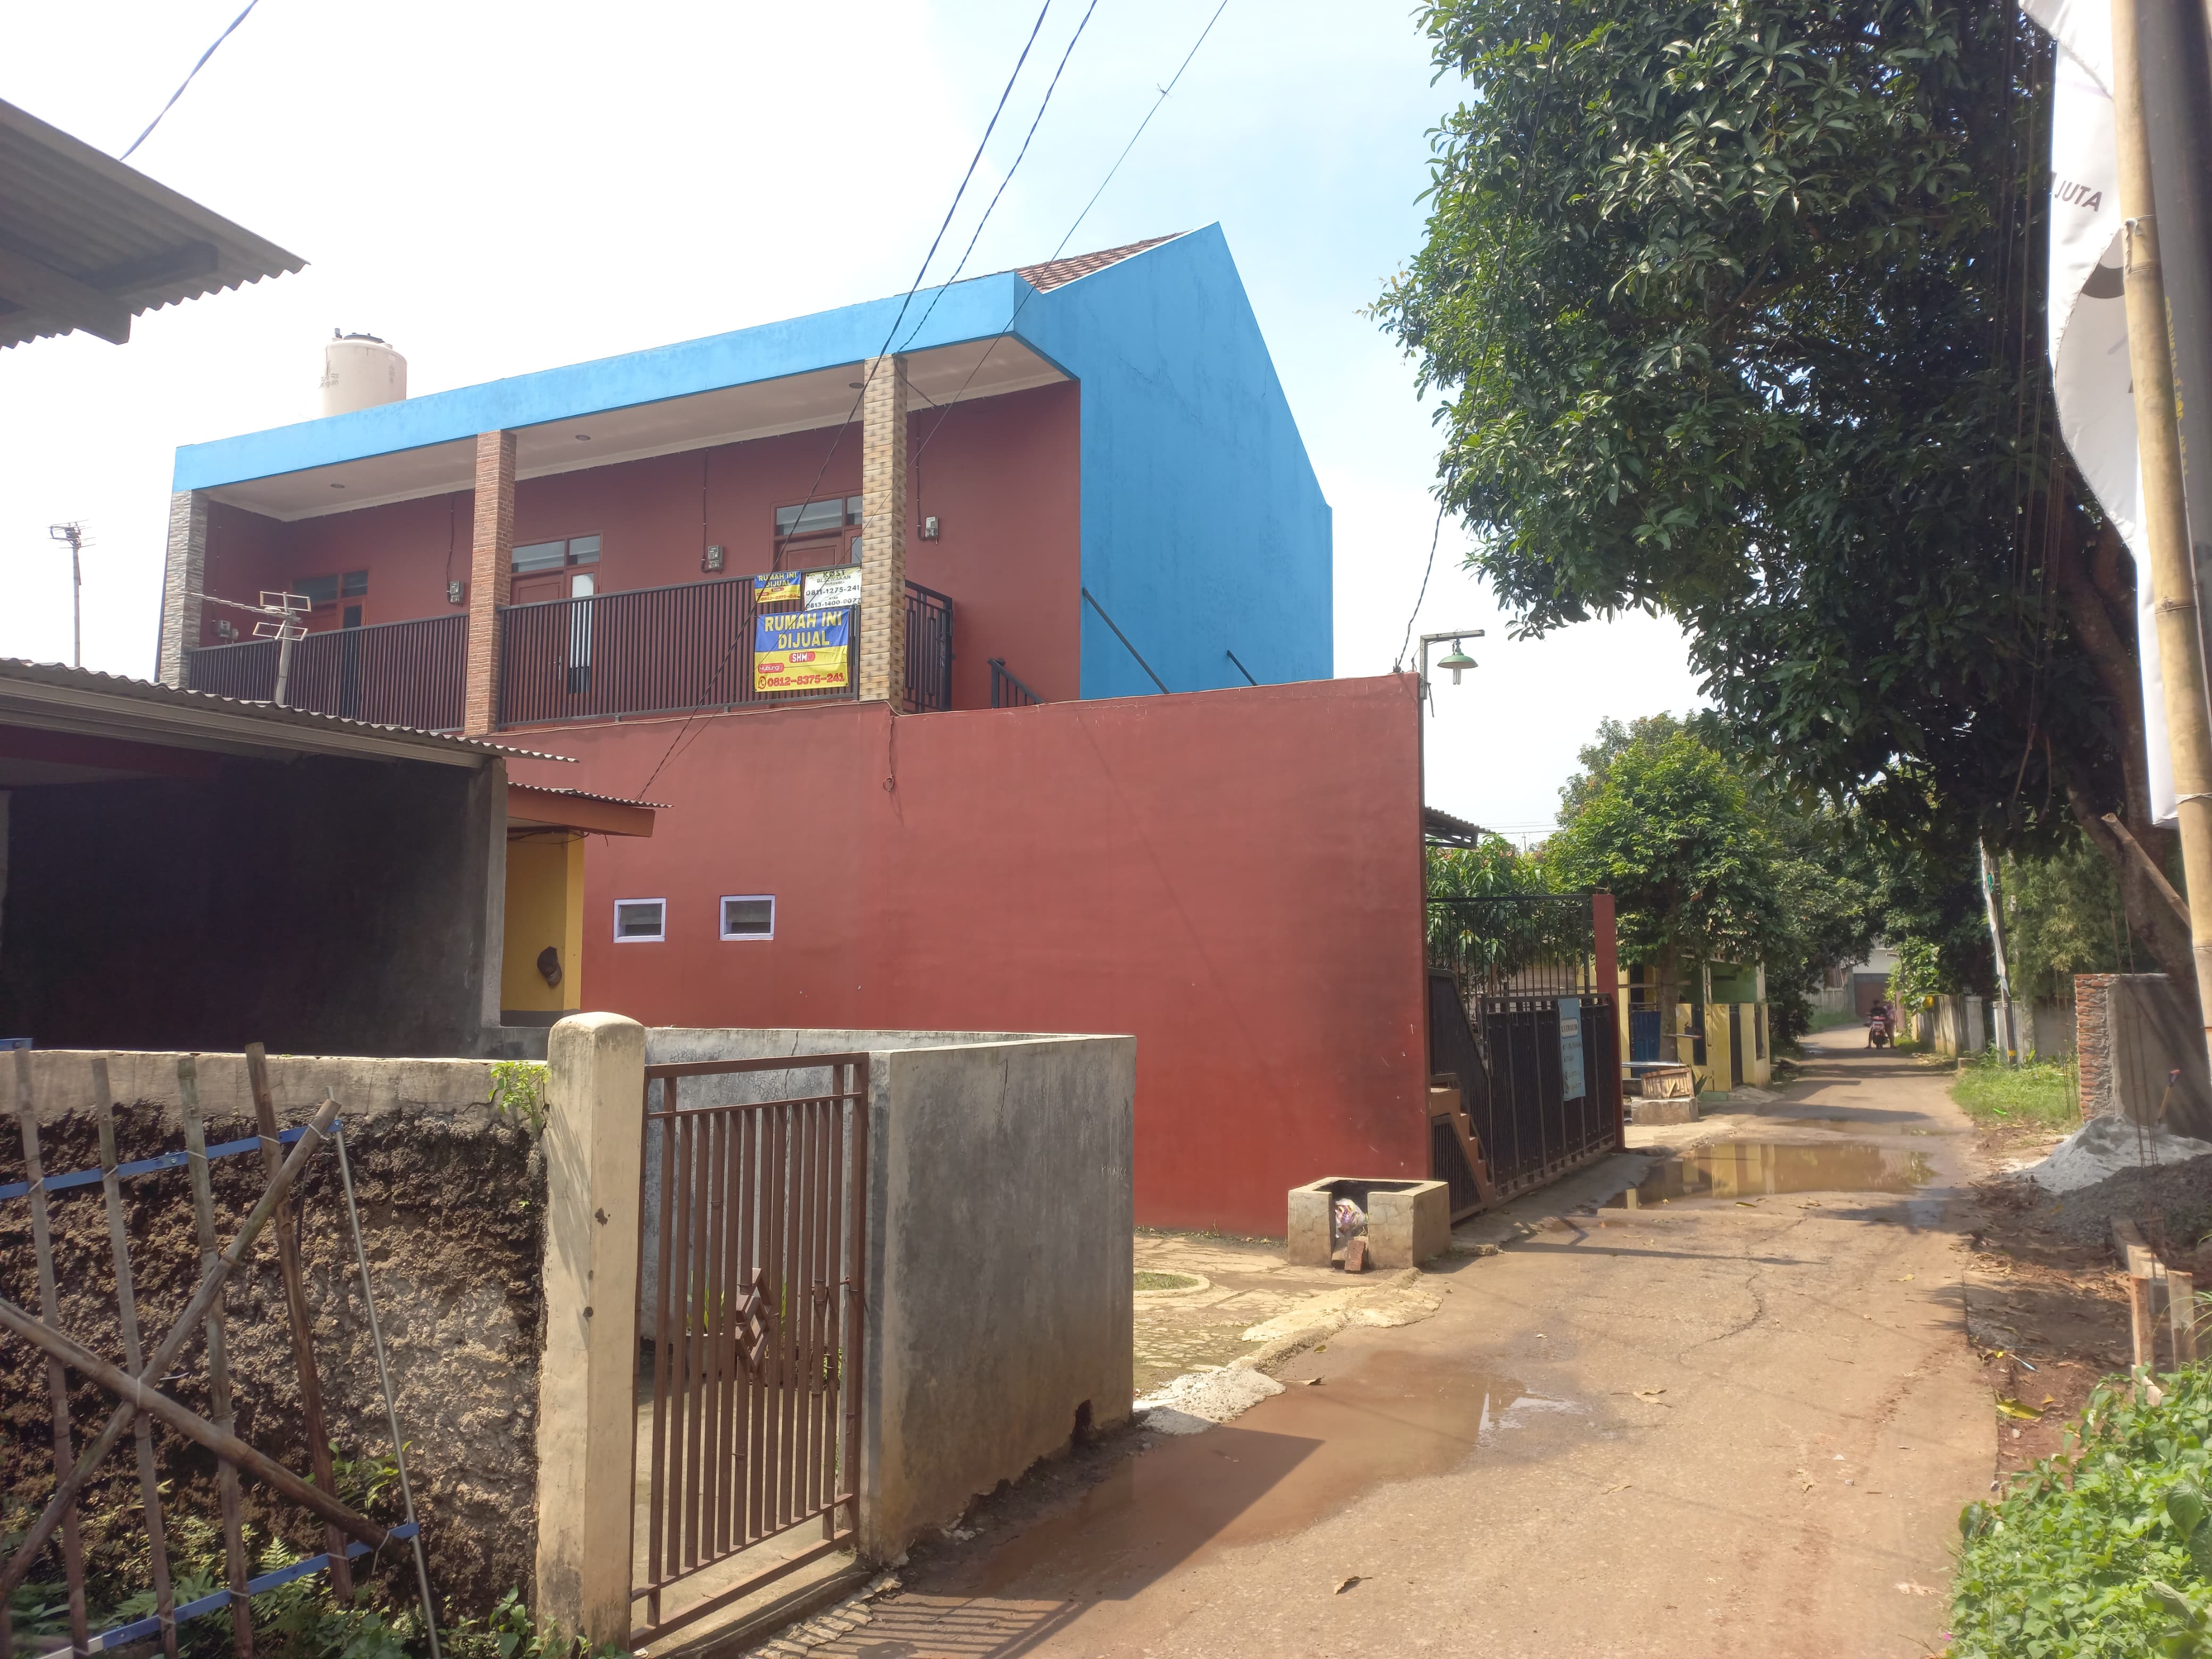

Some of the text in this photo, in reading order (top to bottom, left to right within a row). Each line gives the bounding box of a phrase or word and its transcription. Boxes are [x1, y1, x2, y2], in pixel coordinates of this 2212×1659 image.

[2055, 180, 2103, 213] JUTA
[758, 573, 784, 582] RUMAH
[806, 585, 859, 596] 0811-1275-241
[765, 611, 843, 632] RUMAH INI
[778, 630, 830, 649] DIJUAL
[792, 653, 808, 663] SHM
[767, 673, 844, 686] 0812-8375-241
